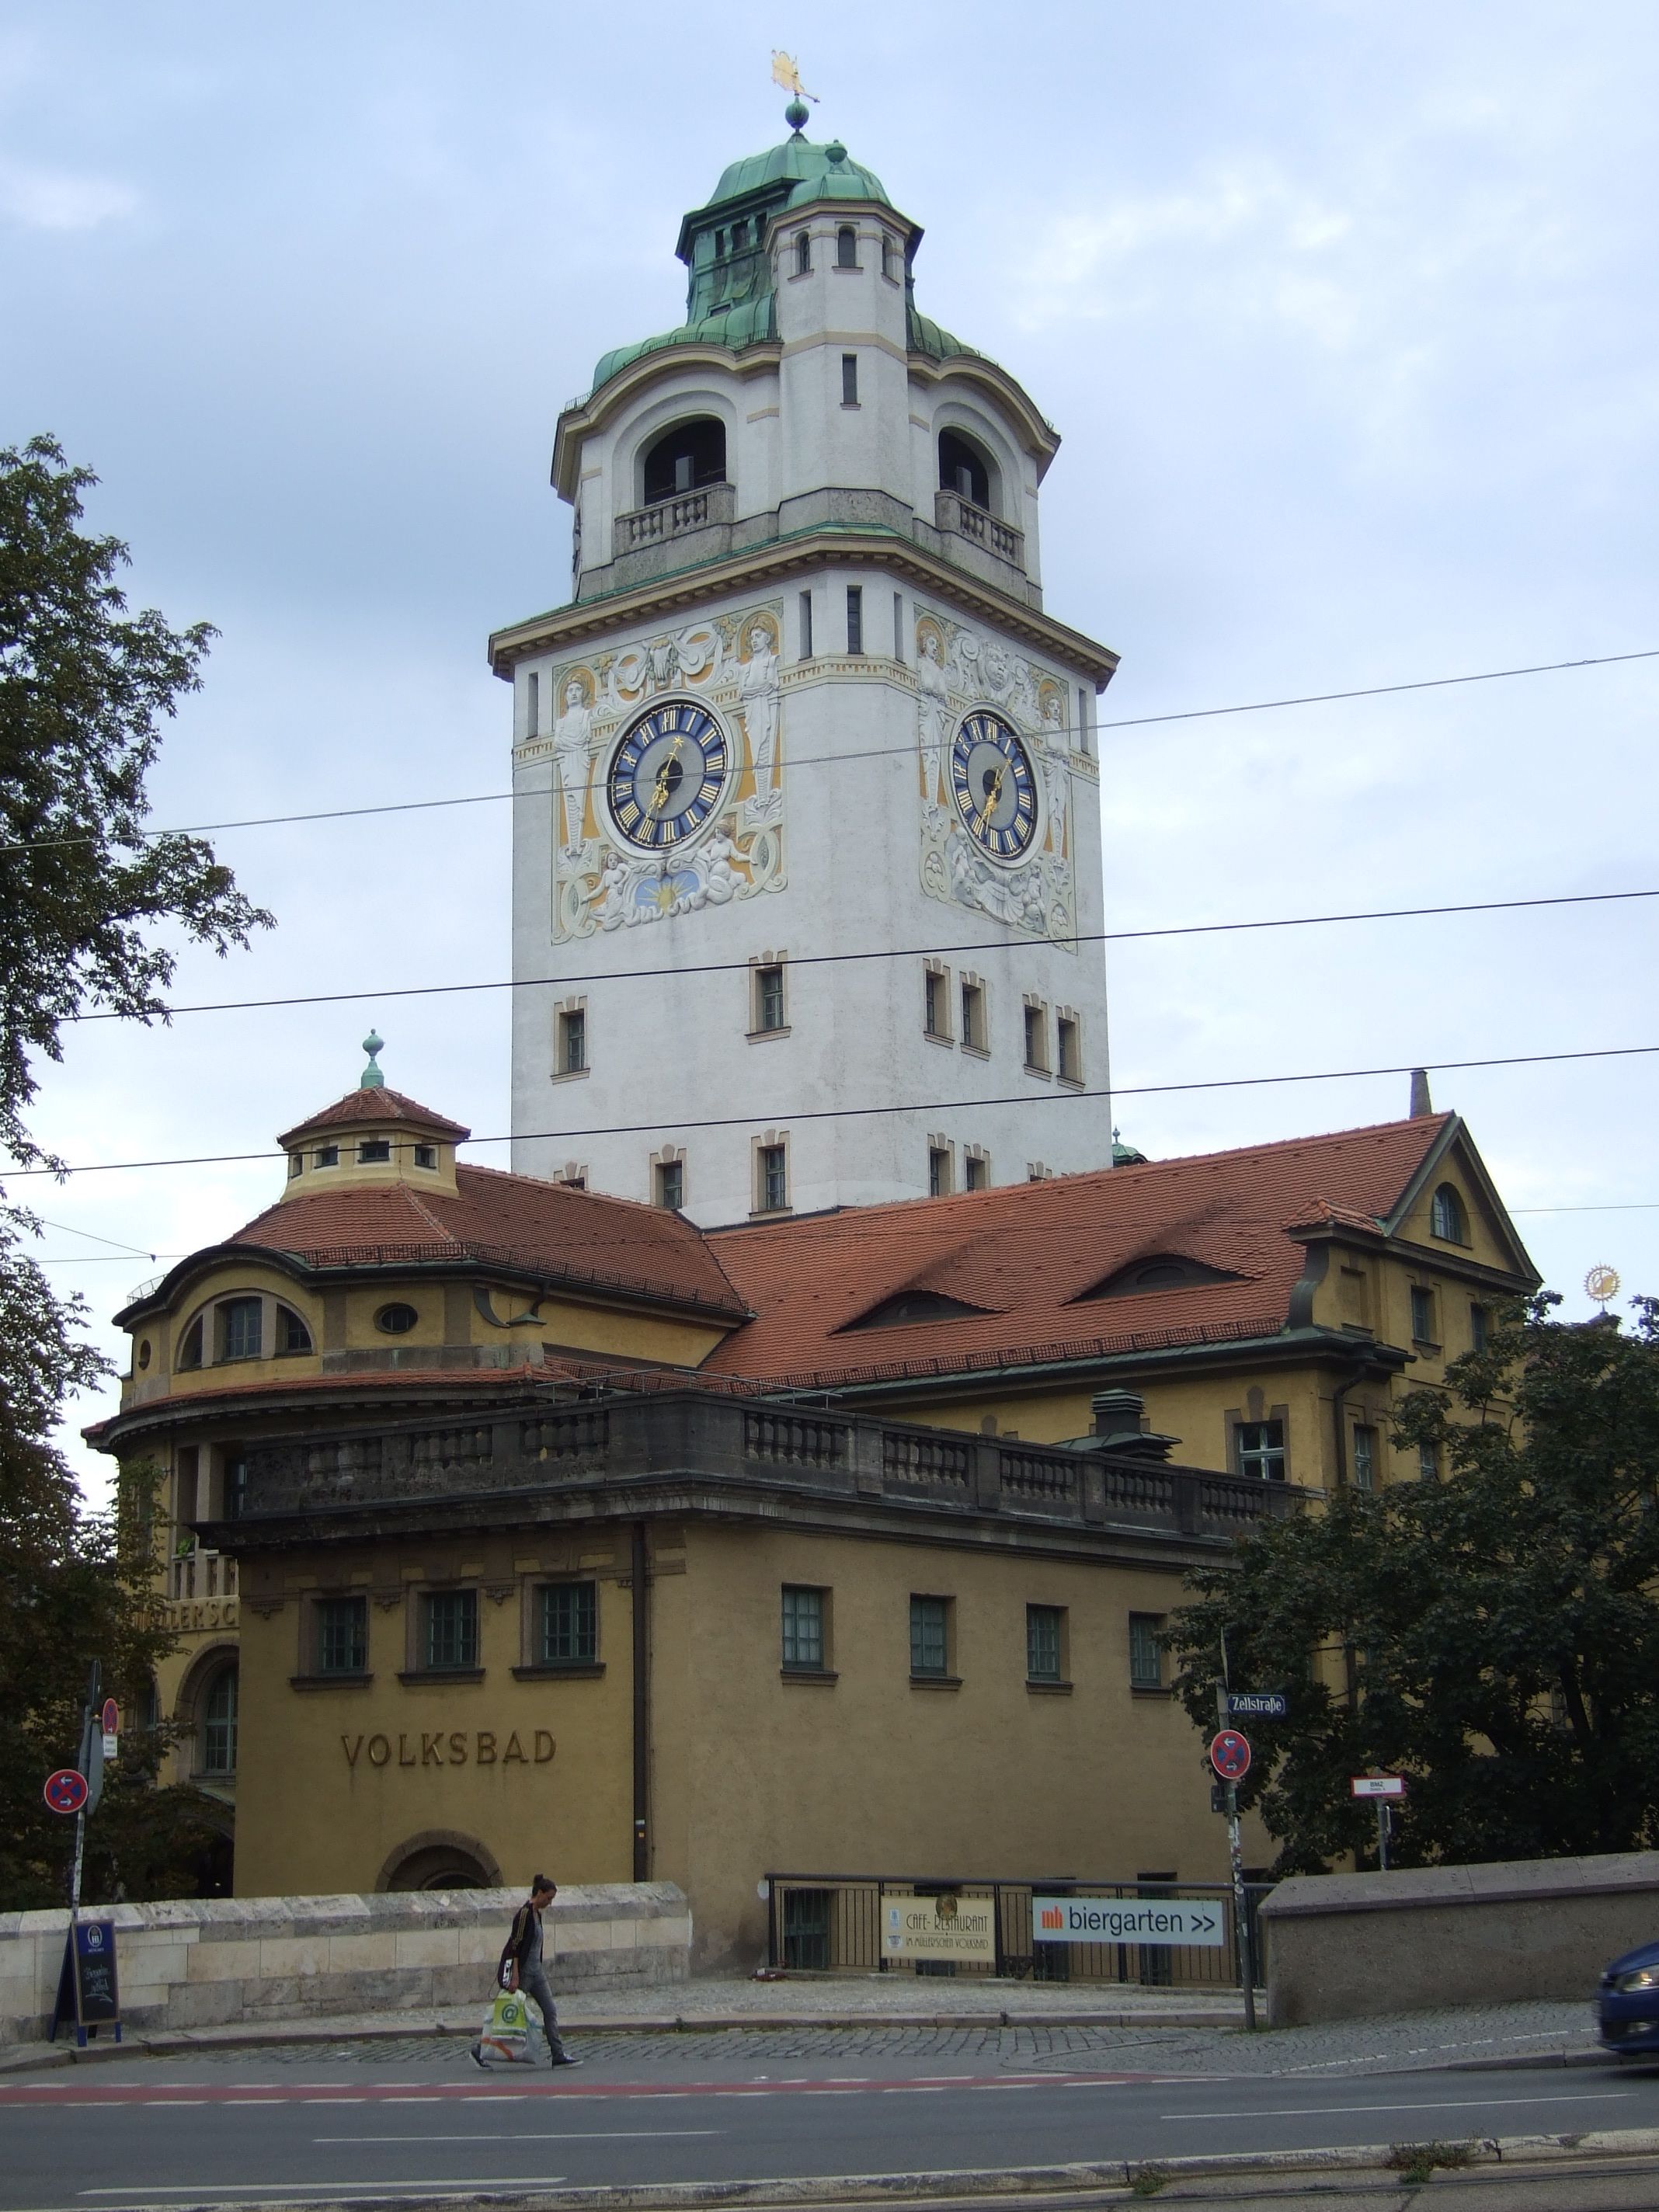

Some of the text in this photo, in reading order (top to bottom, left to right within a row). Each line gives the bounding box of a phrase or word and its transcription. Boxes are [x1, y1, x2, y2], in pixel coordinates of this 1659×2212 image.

[1232, 1696, 1282, 1713] Zellstraße
[340, 1729, 557, 1766] VOLKSBAD
[934, 1914, 988, 1932] RESTAURANT
[1069, 1906, 1183, 1936] biergarten
